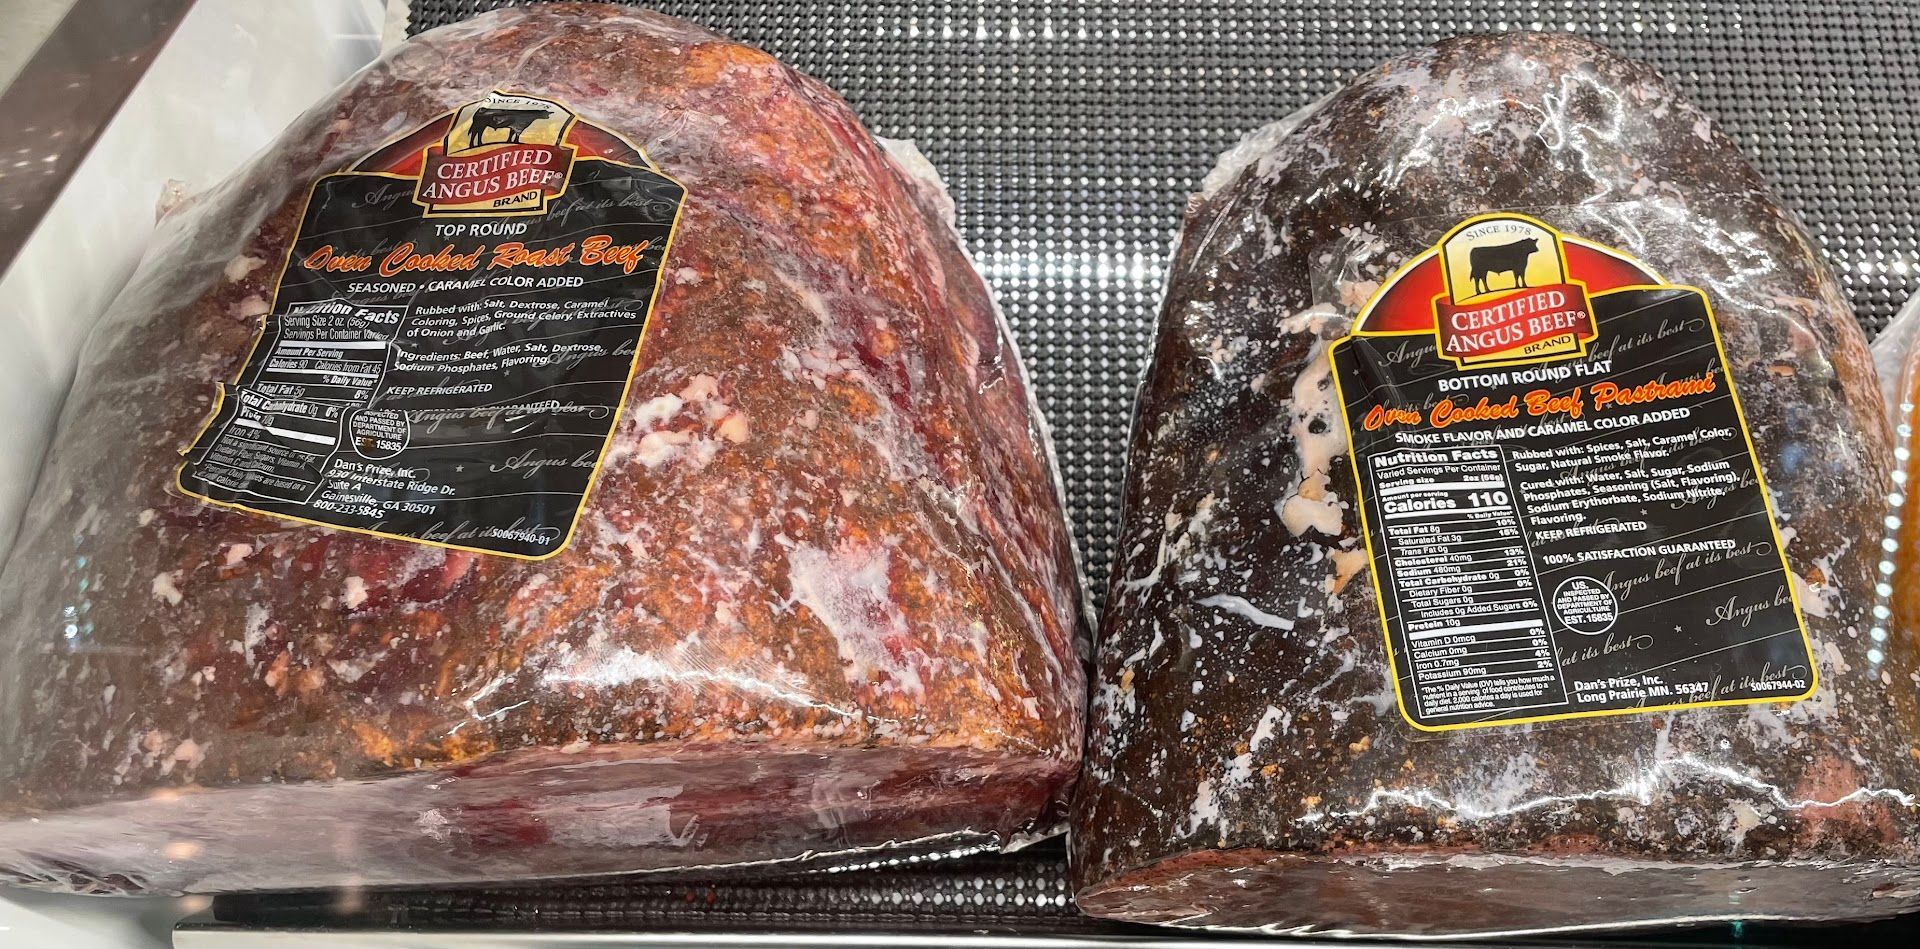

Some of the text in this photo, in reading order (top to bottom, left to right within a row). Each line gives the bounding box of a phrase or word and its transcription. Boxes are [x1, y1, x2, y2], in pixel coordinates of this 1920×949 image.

[437, 150, 552, 180] CERTIFIED
[423, 179, 500, 199] ANGUS
[493, 191, 538, 208] BRAND
[435, 223, 528, 237] TOP ROUND
[1505, 224, 1532, 236] 1978
[304, 235, 649, 278] Oven Cooked Roast Beef
[347, 276, 584, 293] SEASONED CARAMEL COLOR ADDED
[415, 299, 609, 315] Rubbed with: Salt, Dextrose, Caramel
[1451, 290, 1565, 331] CERTIFIED
[284, 315, 310, 328] Serving
[312, 315, 327, 327] Size
[328, 316, 333, 327] 2
[347, 317, 369, 329] (56g)
[411, 310, 637, 328] Coloring, Spices, Ground Celery, Extractives
[283, 329, 363, 340] Servings Per Container
[407, 322, 506, 337] of Onion and Garlic.
[1446, 323, 1523, 353] ANGUS
[395, 342, 604, 362] Ingredients: Beef, Water, Salt, Dextrose,
[1524, 335, 1571, 355] BRAND
[394, 361, 435, 372] Sodium
[437, 363, 498, 375] Phosphates,
[1438, 360, 1612, 392] BOTTOM ROUND FLAT
[387, 383, 493, 396] KEEP REFRIGERATED
[1363, 371, 1716, 432] Oven Cooked Beef Pastrami
[352, 421, 397, 432] DEPARTMENT
[369, 417, 396, 426] PASSED
[396, 420, 405, 428] BY
[1395, 407, 1691, 445] SMOKE FLAVOR AND CARAMEL COLOR ADDED
[356, 429, 402, 440] AGRICULTURE
[1512, 427, 1732, 460] Rubbed with: Spices, Salt, Caramel Color,
[375, 440, 402, 451] 15835
[1374, 449, 1498, 468] Nutrition Facts
[1515, 448, 1670, 473] Sugar, Natural Smoke Flavor.
[334, 458, 416, 479] Dan's Prize, Inc.
[1377, 464, 1501, 480] Varied Servings Per Container
[1520, 460, 1730, 491] Cured with: Water, Salt, Sugar, Sodium
[326, 469, 456, 496] 930 Interstate Ridge Dr.
[328, 480, 362, 491] Suite A
[1523, 487, 1591, 503] Phosphates,
[1592, 481, 1649, 495] Seasoning
[1650, 478, 1680, 491] (Salt,
[321, 490, 436, 515] Gainesville, GA 30501
[1384, 491, 1509, 514] Calories 110
[1527, 485, 1726, 514] Sodium Erythorbate, Sodium Nitrite,
[313, 500, 385, 519] 800-233-5845
[1530, 513, 1587, 526] Flavoring.
[1535, 521, 1647, 541] KEEP REFRIGERATED
[1542, 538, 1736, 565] 100% SATISFACTION GUARANTEED
[1655, 541, 1772, 586] beef at its best
[1421, 600, 1538, 618] Includes 0g Added Sugars 0%
[1706, 595, 1769, 628] Angus
[1411, 635, 1476, 649] Vitamin D 0mcg
[1414, 646, 1468, 659] Calcium 0mg
[1418, 667, 1487, 681] Potassium 90mg
[1574, 675, 1664, 691] Dan's Prize, Inc.
[1577, 682, 1710, 703] Long Prairie MN. 56347
